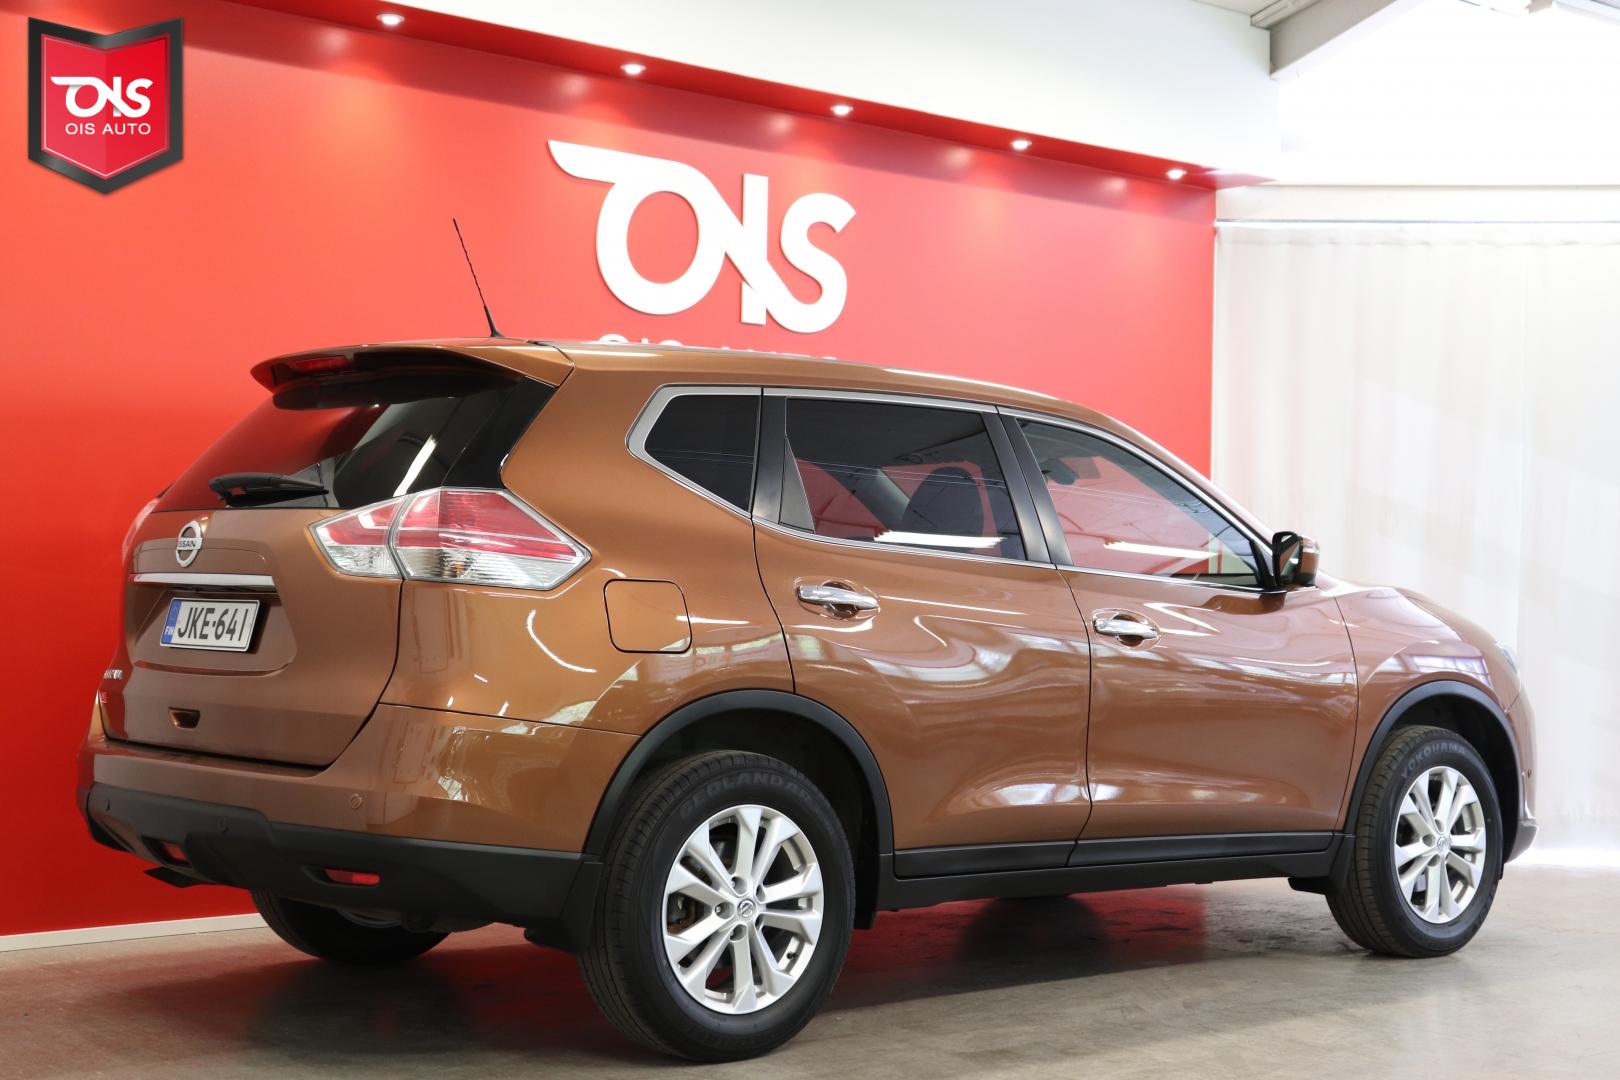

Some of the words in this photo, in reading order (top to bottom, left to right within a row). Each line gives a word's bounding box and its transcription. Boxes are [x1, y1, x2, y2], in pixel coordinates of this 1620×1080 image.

[547, 139, 857, 334] OIS
[178, 607, 248, 641] JKE-641
[1401, 743, 1467, 778] YOKOHAMA
